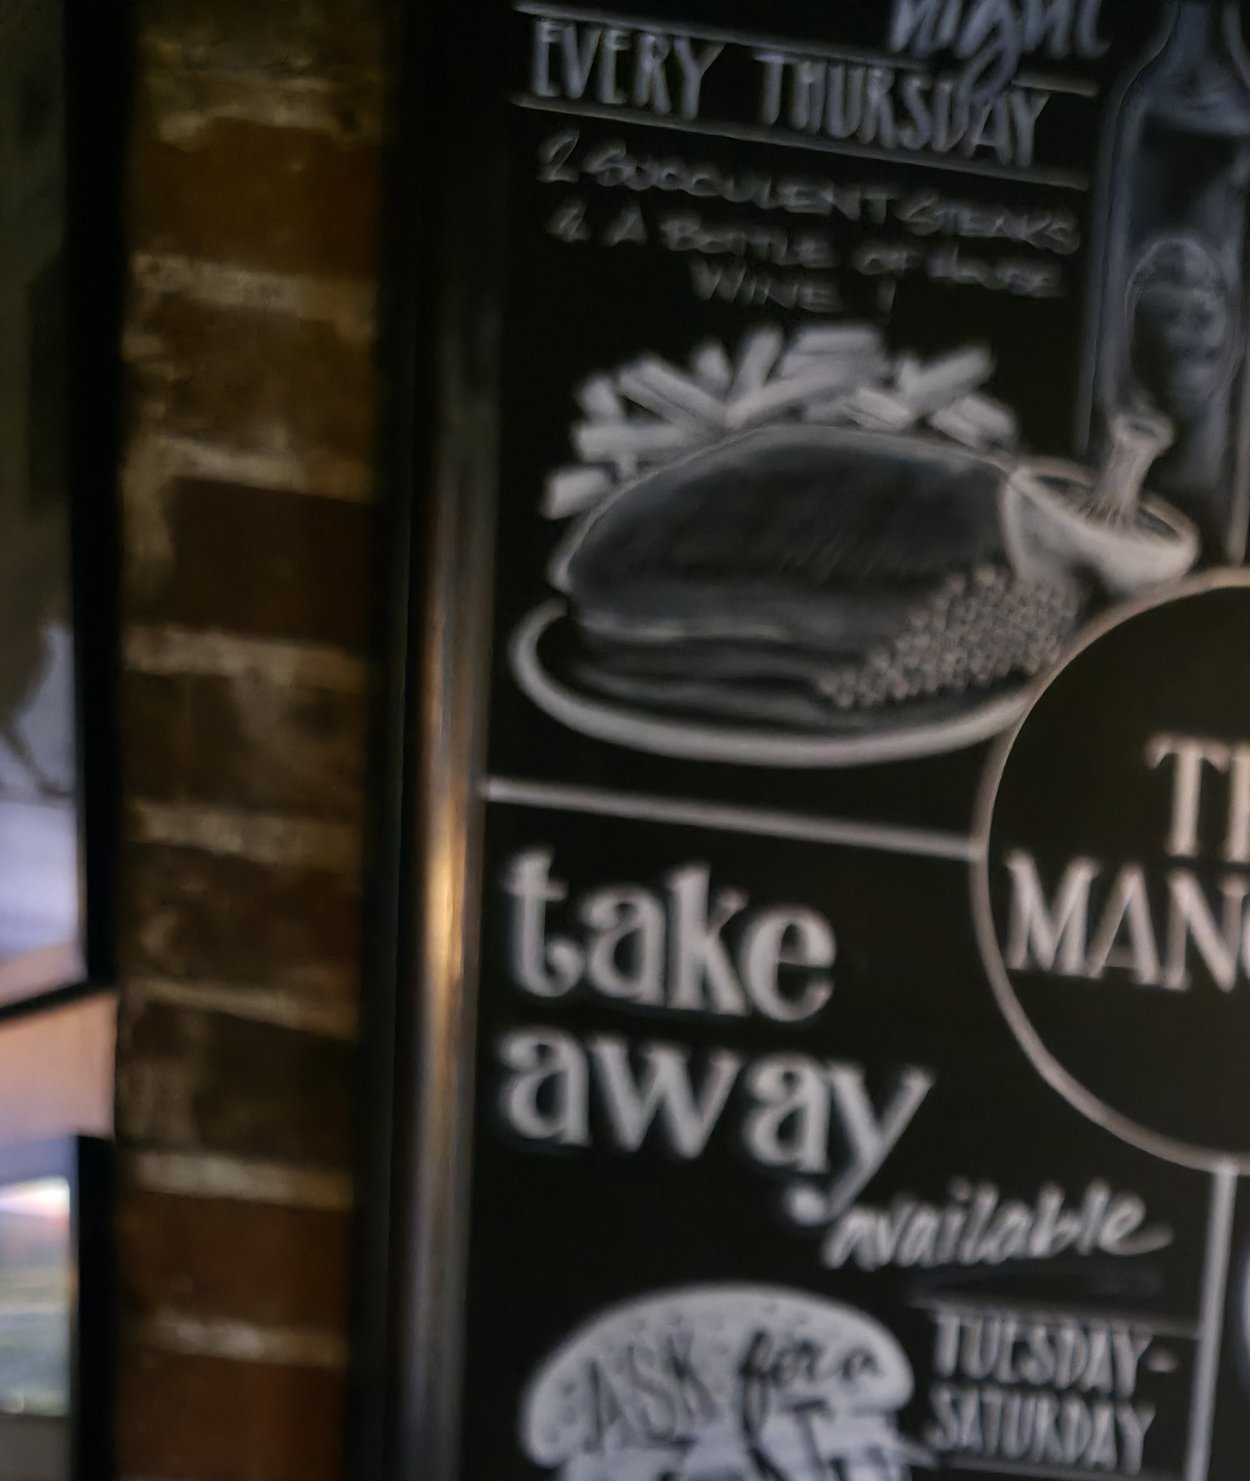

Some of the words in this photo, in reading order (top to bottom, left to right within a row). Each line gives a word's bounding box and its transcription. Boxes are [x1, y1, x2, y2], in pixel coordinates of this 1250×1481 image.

[531, 17, 724, 121] EVERY
[754, 48, 1051, 168] THURSDAY
[505, 847, 838, 1022] take
[499, 1027, 935, 1226] away
[824, 1178, 1172, 1271] available
[583, 1336, 718, 1456] ASK
[926, 1384, 1156, 1475] SATURDAY
